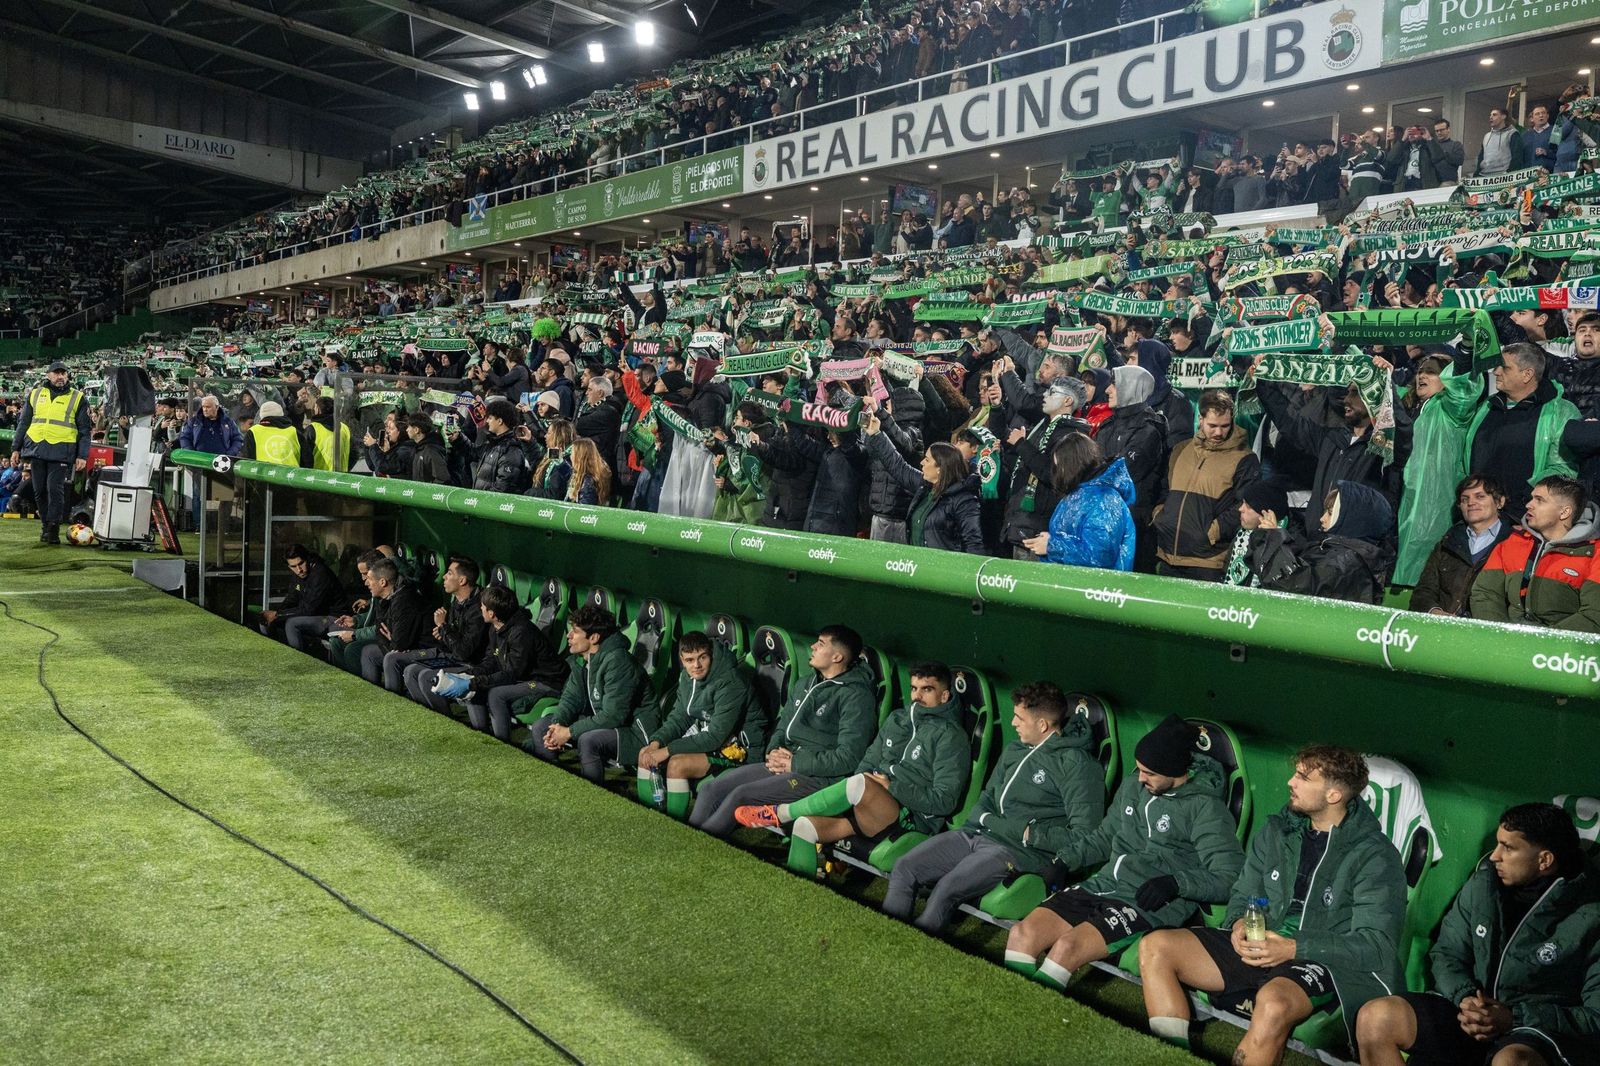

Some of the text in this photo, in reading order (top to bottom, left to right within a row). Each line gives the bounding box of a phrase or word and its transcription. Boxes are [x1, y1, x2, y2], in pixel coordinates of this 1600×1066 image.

[1439, 0, 1544, 25] POL
[1442, 0, 1600, 36] CONCEJALÍA DE DEPOR
[776, 19, 1306, 183] REAL RACING CLUB
[165, 134, 184, 148] EL
[185, 137, 235, 157] DIARIO
[685, 155, 739, 183] ¡PIÉLAGOS VIVE
[690, 174, 734, 194] EL DEPORTE!
[1483, 173, 1514, 186] RACING
[1167, 245, 1215, 258] SANTA
[582, 293, 606, 301] RACING
[1500, 286, 1537, 304] AUPA
[1363, 330, 1395, 338] LLUEVA
[1409, 330, 1438, 338] SOPLE
[352, 348, 379, 359] RACING
[632, 341, 661, 355] RACING
[728, 352, 790, 372] REAL RACING CLUB
[802, 403, 849, 428] RACING
[499, 501, 515, 514] cabify
[536, 507, 553, 522] cabify
[580, 514, 599, 527] cabify
[627, 520, 648, 535] cabify
[680, 527, 704, 543] cabify
[740, 535, 766, 553] cabify
[808, 547, 837, 566] cabify
[885, 558, 918, 578] cabify
[979, 574, 1018, 593] cabify
[1084, 587, 1129, 608] cabify
[1207, 605, 1260, 629] cabify
[1356, 626, 1419, 653] cabify
